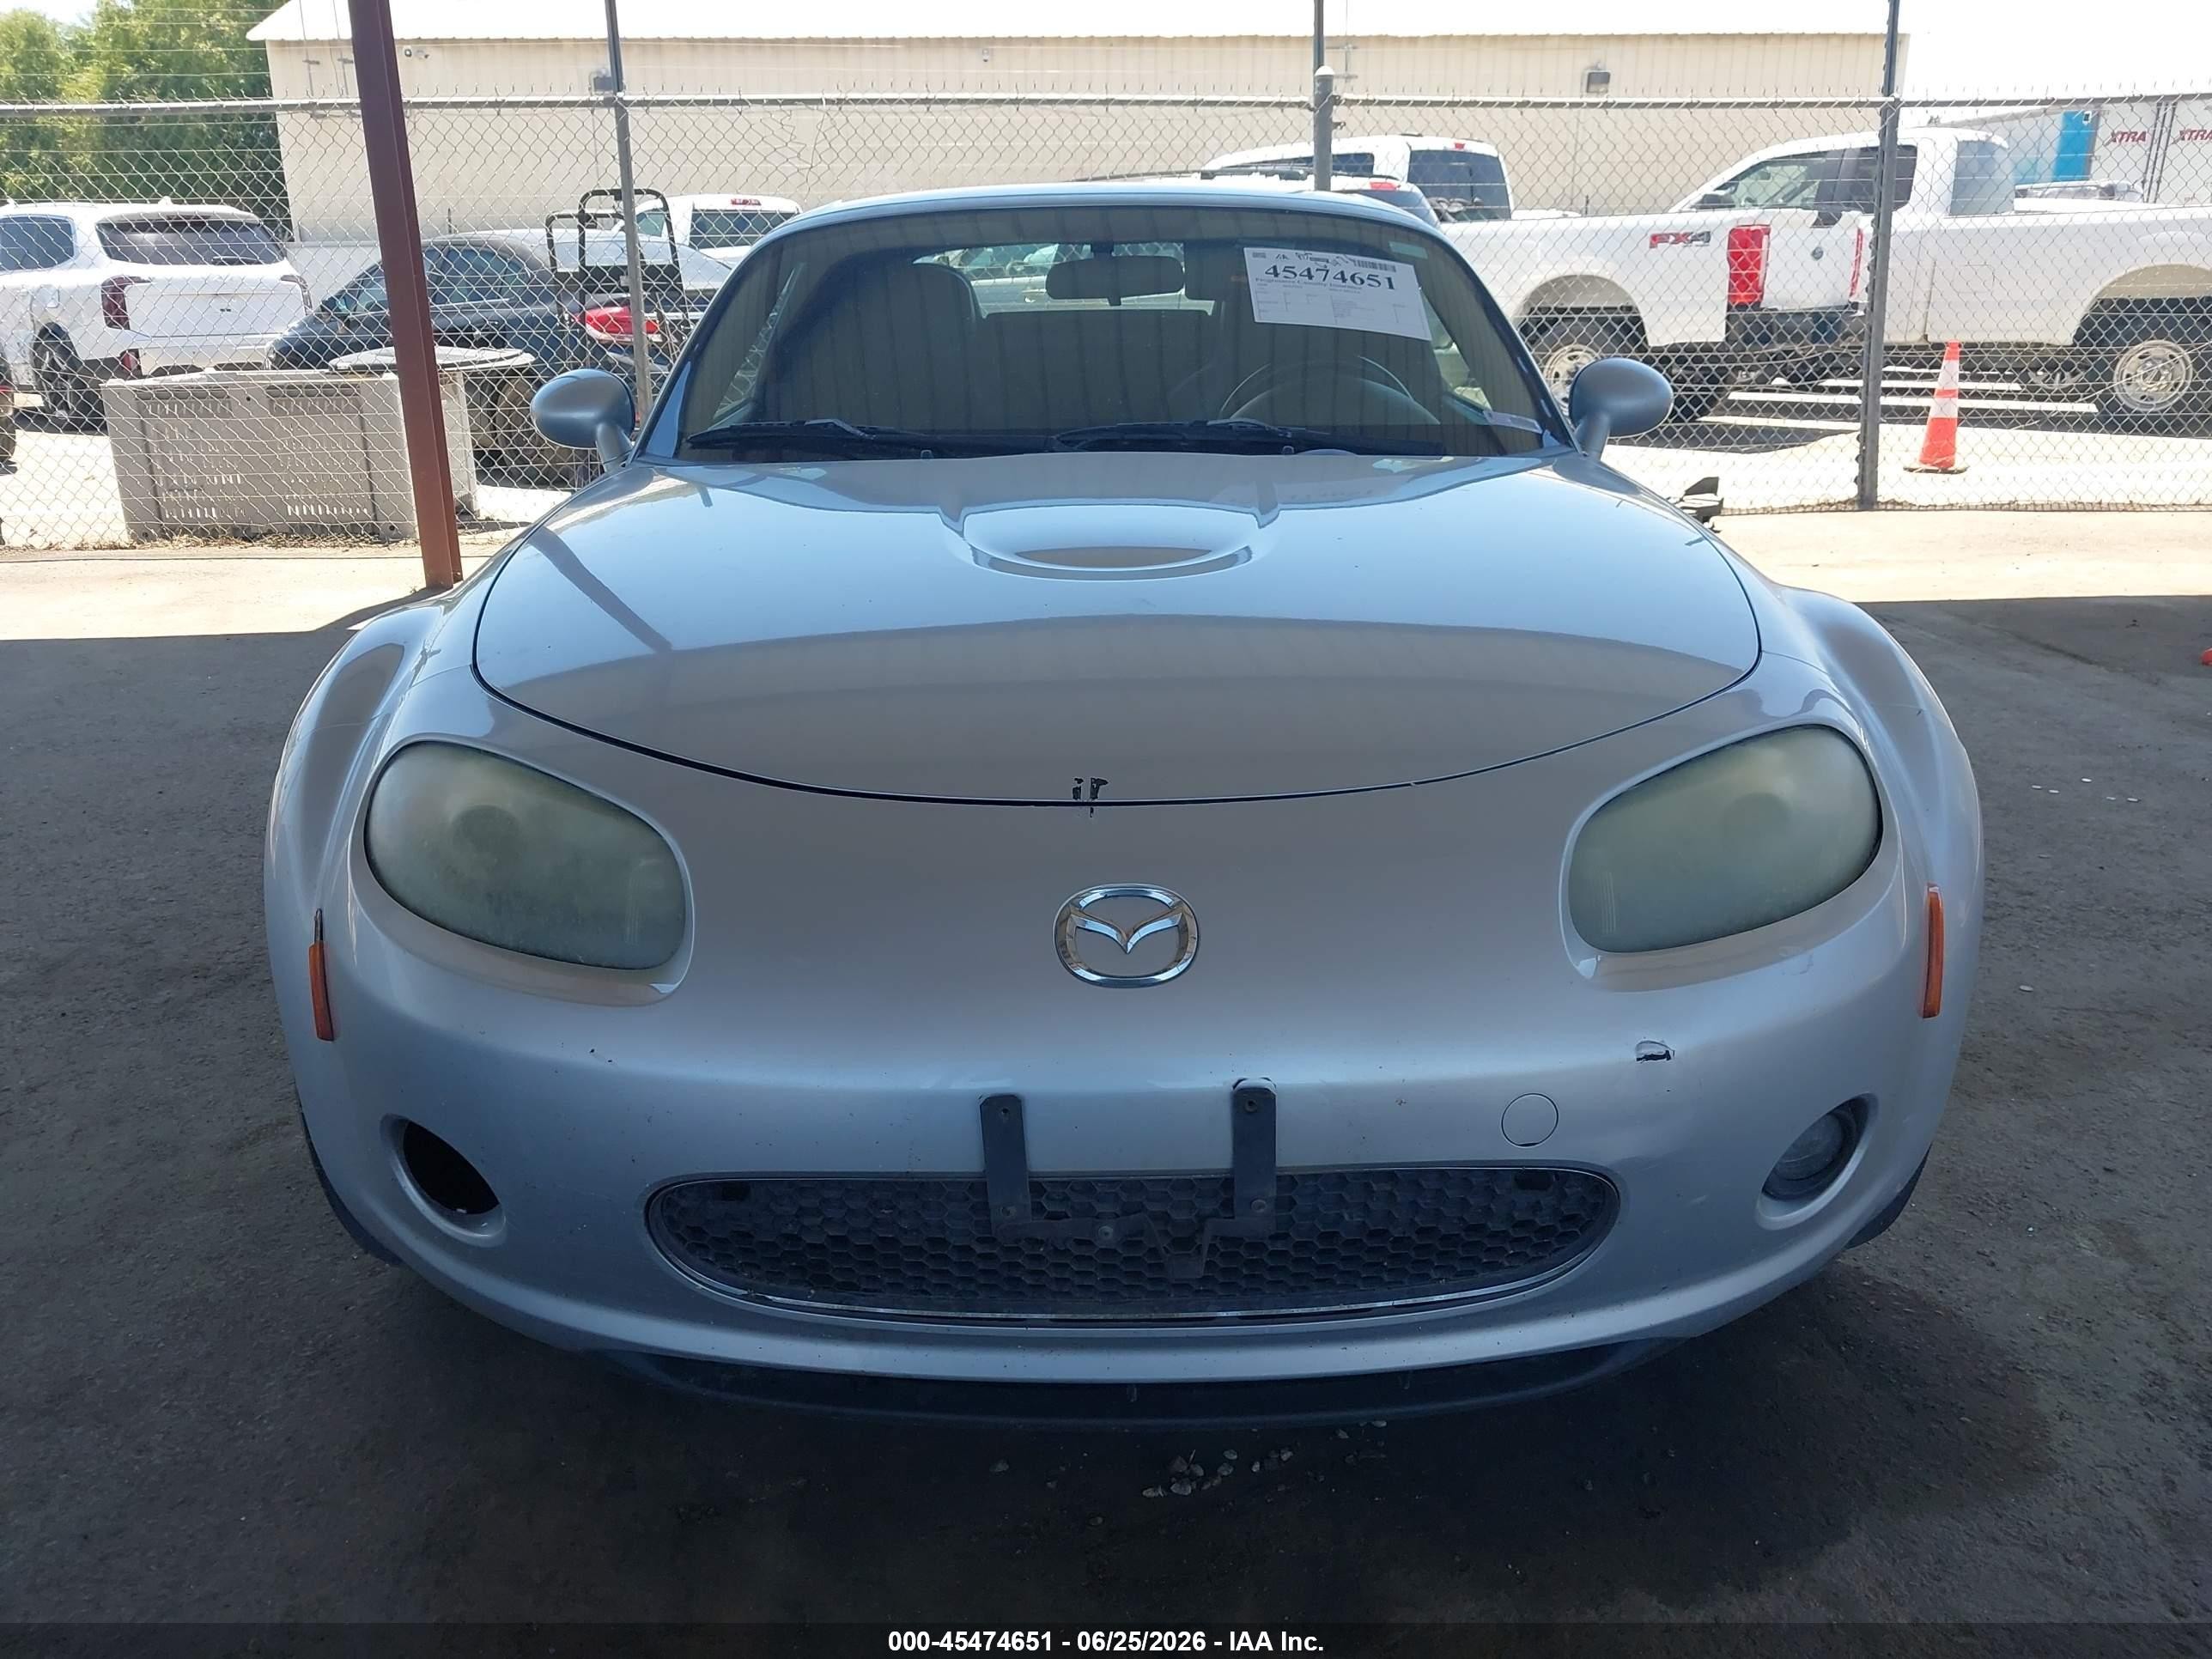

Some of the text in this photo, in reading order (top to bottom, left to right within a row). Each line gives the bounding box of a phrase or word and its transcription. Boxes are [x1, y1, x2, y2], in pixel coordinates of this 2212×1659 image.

[2105, 130, 2147, 145] XTRA
[1649, 230, 1711, 249] FX4
[1264, 264, 1396, 290] 45474651
